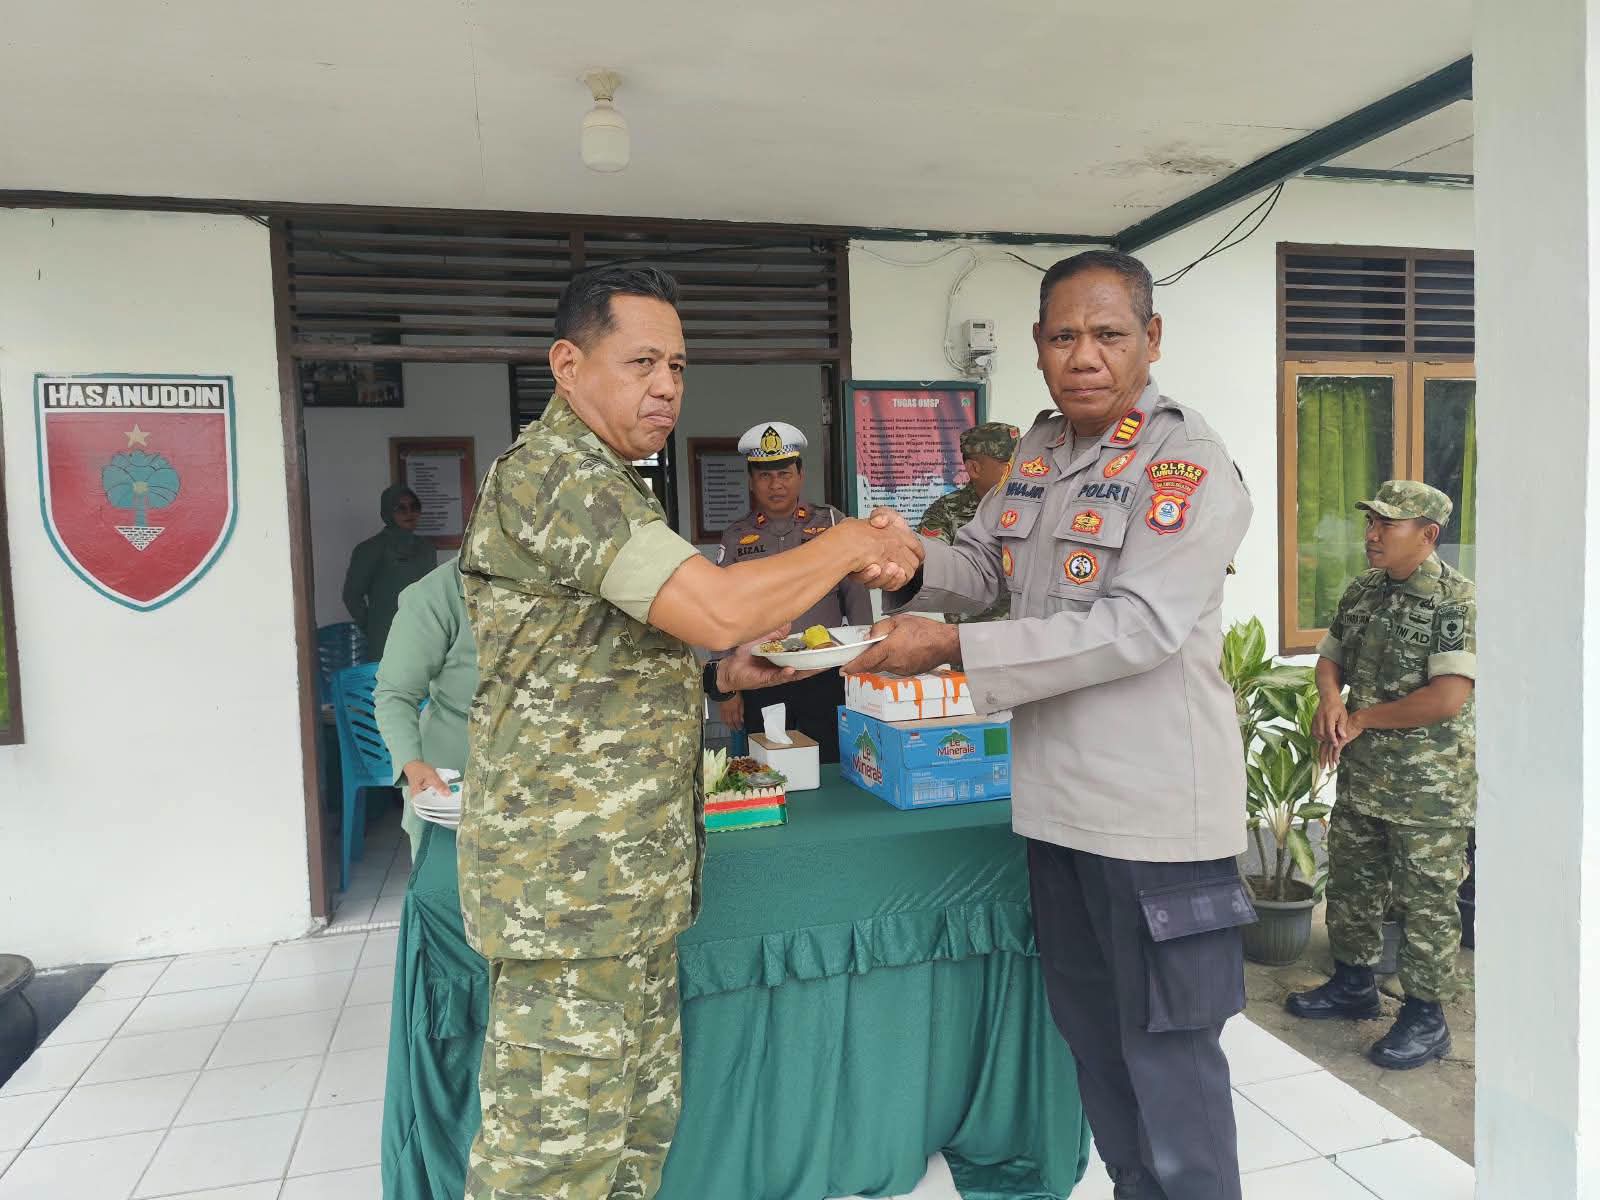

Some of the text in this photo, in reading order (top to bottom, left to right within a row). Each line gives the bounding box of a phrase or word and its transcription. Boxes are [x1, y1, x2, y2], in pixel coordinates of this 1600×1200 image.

[48, 385, 221, 407] HASANUDDIN
[893, 398, 917, 408] TUGAS
[1151, 463, 1202, 477] POLRES
[1152, 469, 1198, 482] LUWU UTARA
[1078, 483, 1130, 503] POLRI
[737, 544, 767, 557] RIZAL
[1395, 625, 1430, 644] TNI AD
[937, 743, 976, 756] Minerale
[950, 738, 960, 747] Le
[862, 742, 872, 761] Le
[851, 752, 883, 785] Minerale
